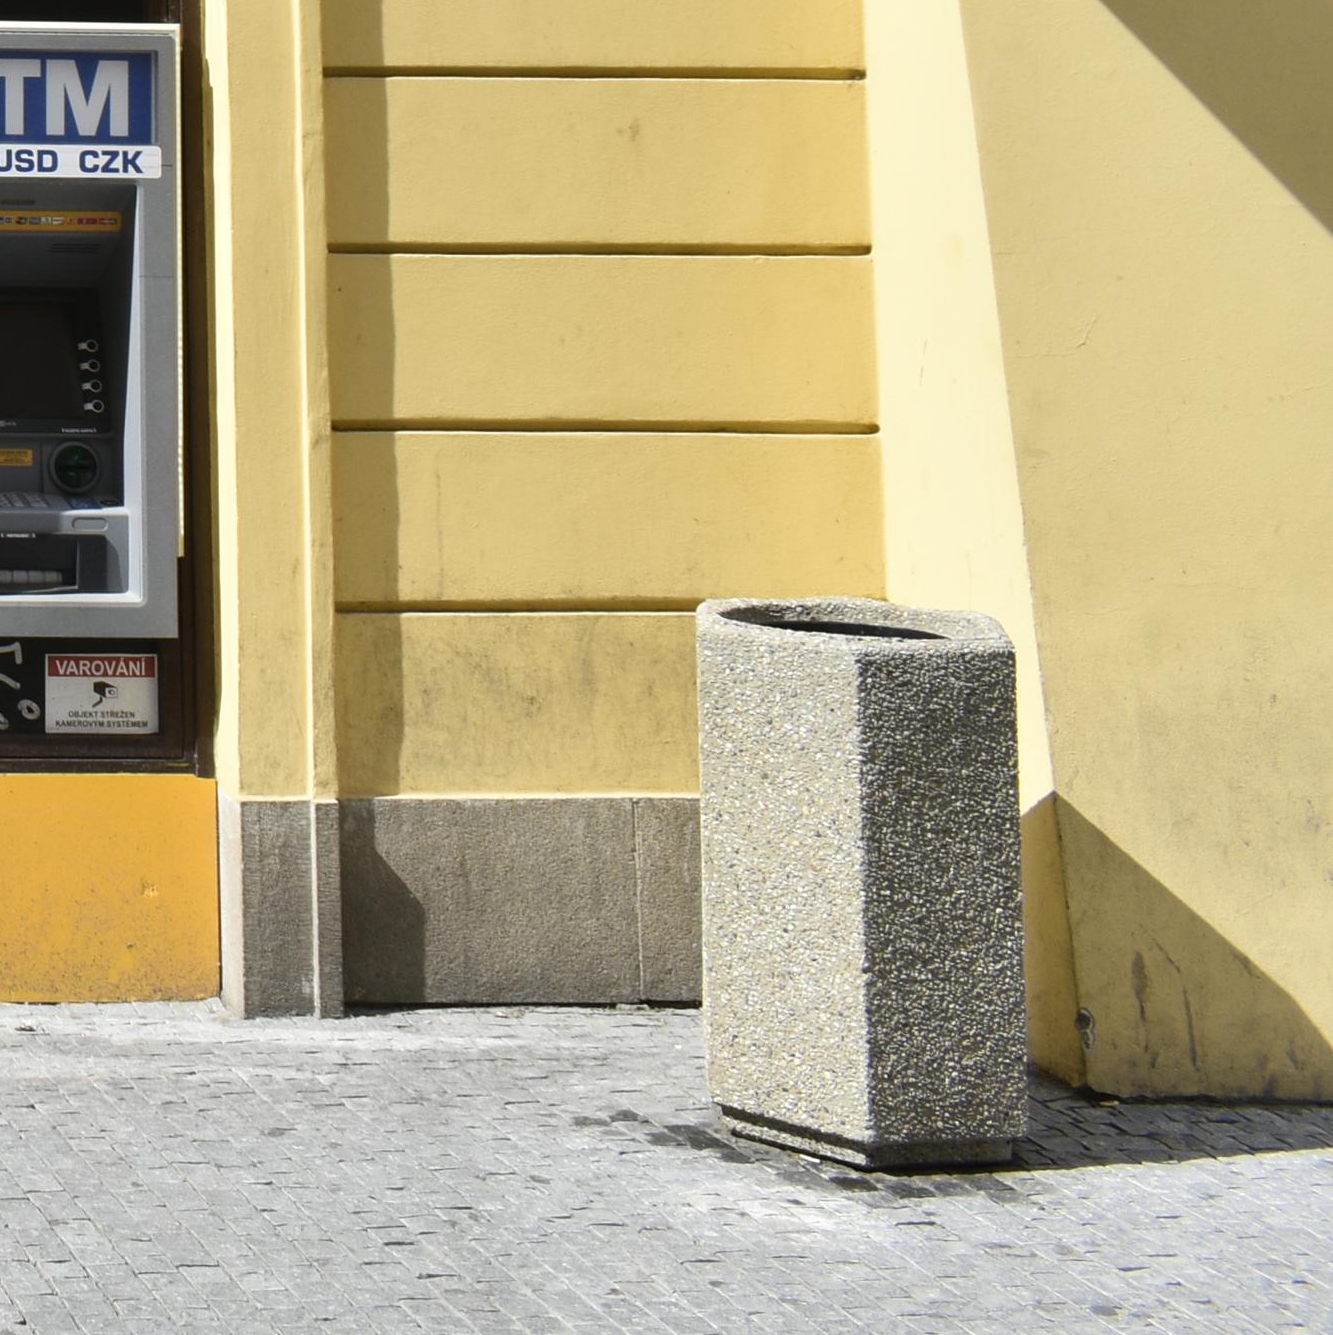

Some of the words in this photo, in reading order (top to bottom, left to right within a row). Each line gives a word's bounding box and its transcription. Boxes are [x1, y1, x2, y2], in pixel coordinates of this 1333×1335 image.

[79, 150, 144, 173] CZK
[55, 657, 146, 676] VAROVÁNÍ
[68, 710, 98, 718] OBJEKT
